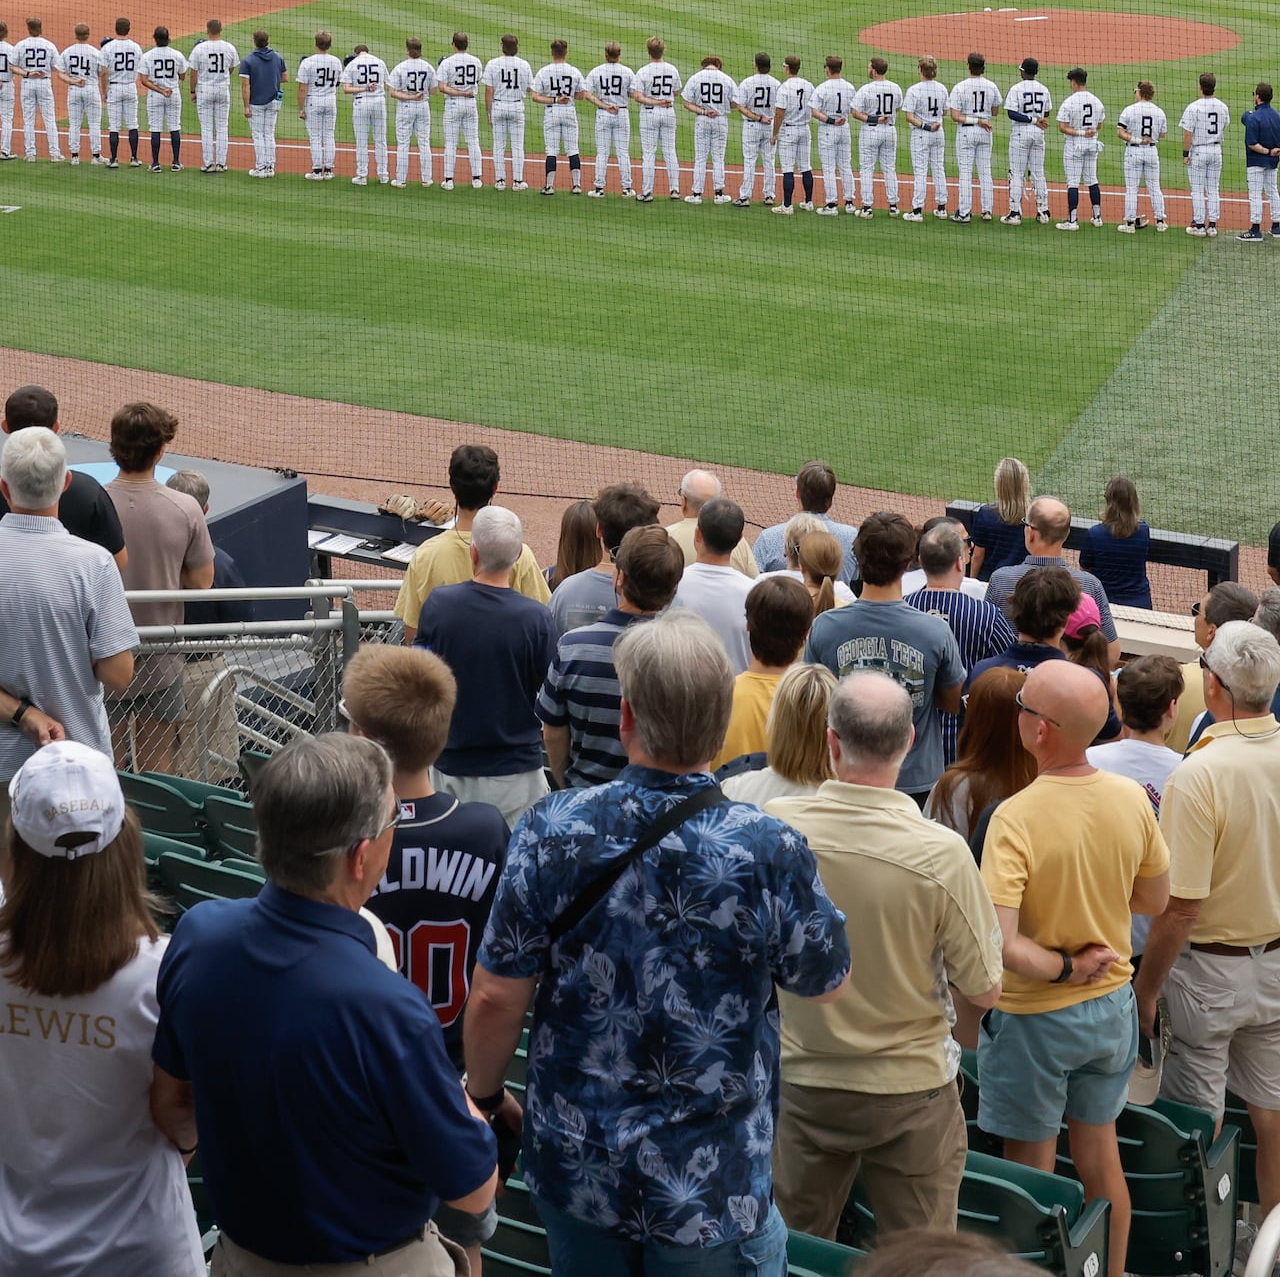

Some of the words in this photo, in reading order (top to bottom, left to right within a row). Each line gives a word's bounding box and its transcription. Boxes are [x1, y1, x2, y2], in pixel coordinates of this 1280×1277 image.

[26, 48, 47, 68] 22
[70, 55, 90, 75] 24
[114, 52, 135, 71] 26
[154, 59, 175, 78] 29
[208, 53, 225, 73] 31
[315, 68, 336, 87] 34
[357, 64, 379, 84] 35
[407, 71, 428, 92] 37
[455, 64, 476, 85] 39
[501, 68, 519, 89] 41
[550, 75, 572, 96] 43
[600, 75, 622, 96] 49
[651, 75, 672, 96] 55
[700, 82, 723, 104] 99
[754, 87, 771, 108] 21
[796, 89, 804, 110] 7
[835, 92, 842, 114] 1
[875, 93, 894, 115] 10
[928, 96, 939, 117] 4
[972, 91, 985, 113] 11
[1023, 92, 1044, 113] 25
[1082, 104, 1093, 126] 2
[1208, 112, 1218, 135] 3
[1141, 116, 1153, 138] 8
[837, 637, 888, 668] GEORGIA
[891, 639, 924, 673] TECH
[386, 918, 471, 1028] 0
